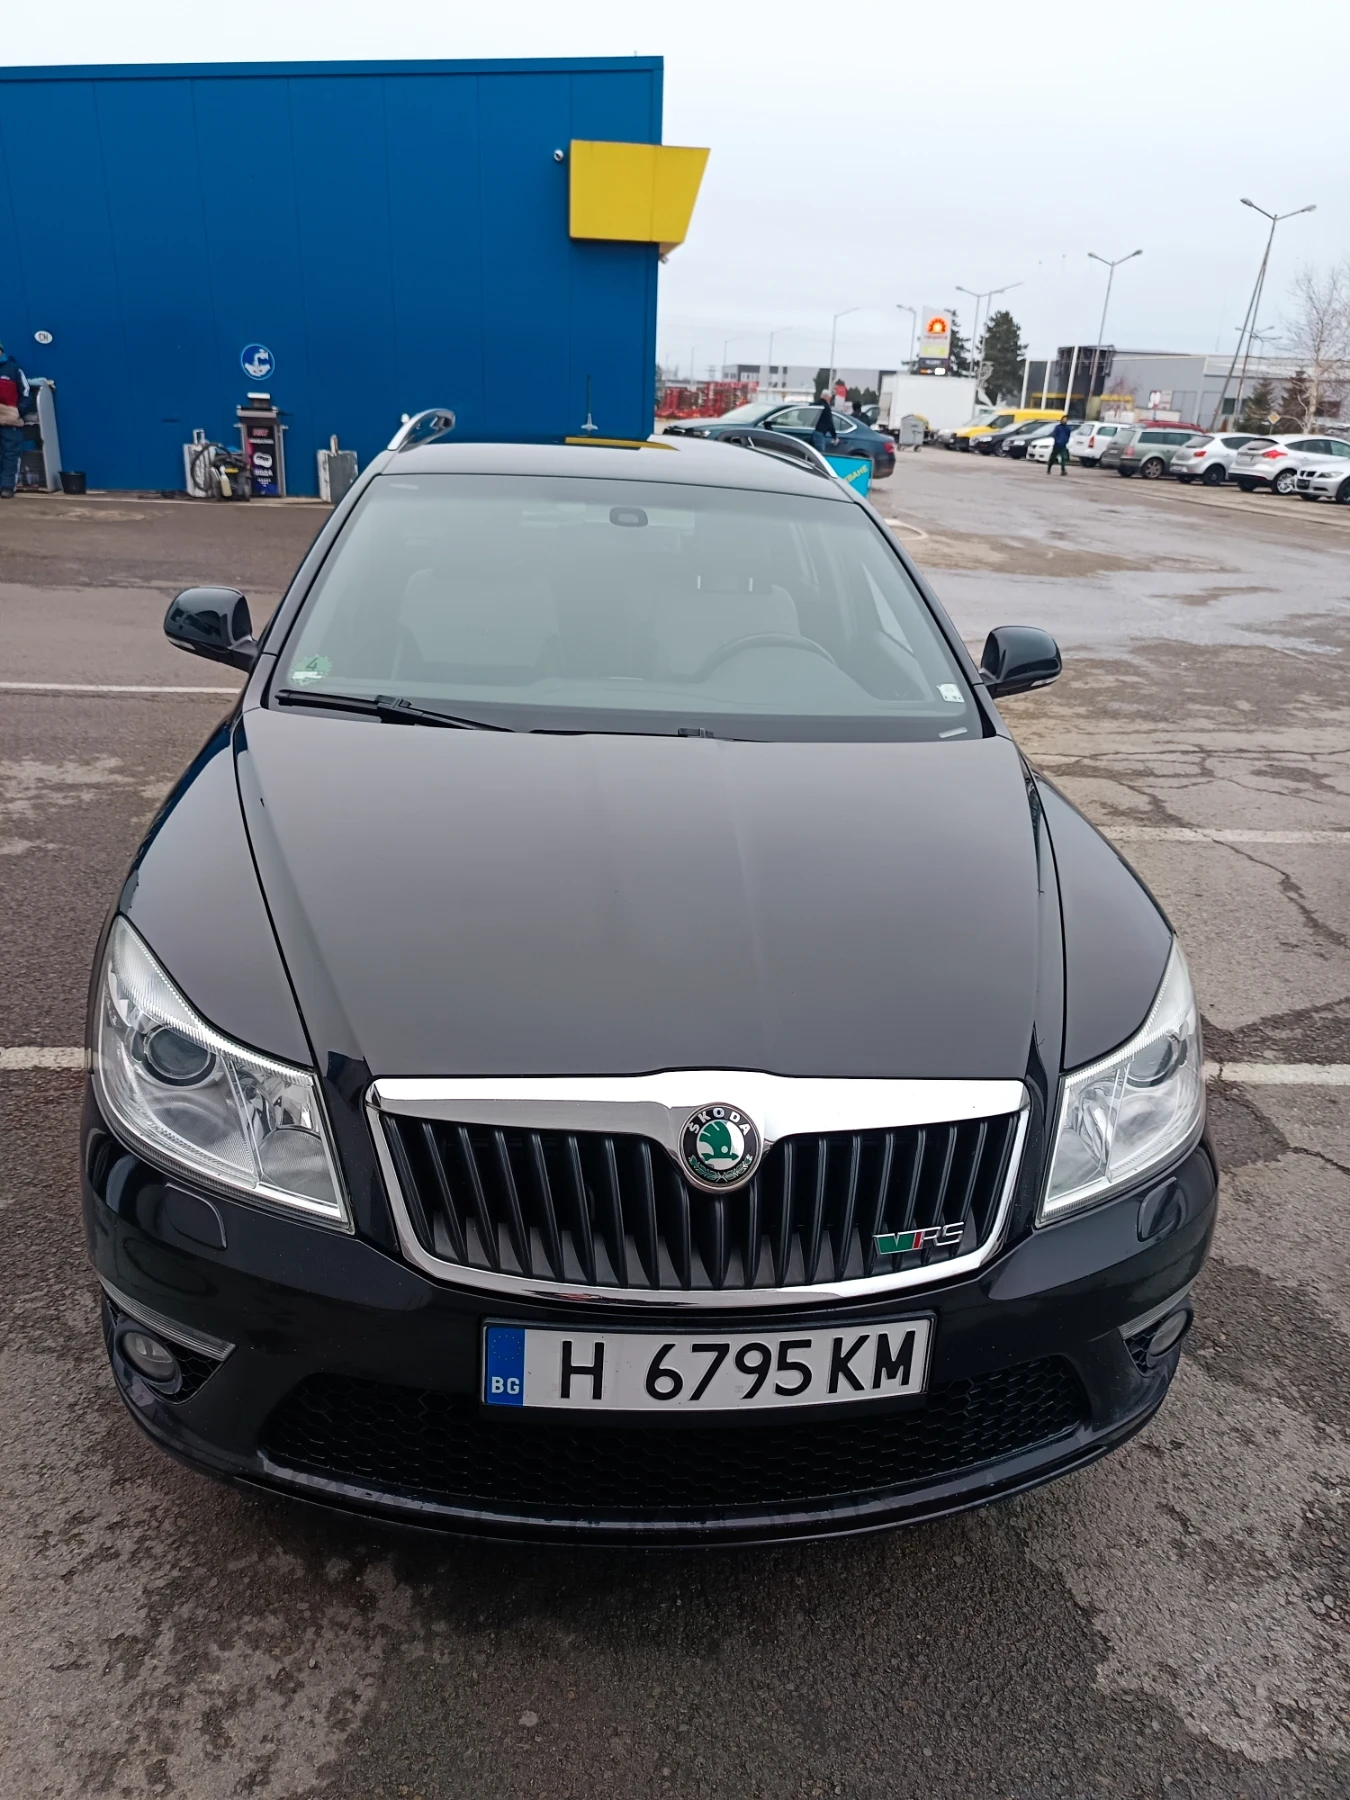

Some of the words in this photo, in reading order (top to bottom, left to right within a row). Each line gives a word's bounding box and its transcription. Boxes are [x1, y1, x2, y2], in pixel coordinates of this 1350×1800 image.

[306, 657, 319, 671] 4
[561, 1341, 604, 1399] H
[646, 1339, 812, 1400] 6795
[828, 1331, 915, 1393] KM
[491, 1376, 520, 1395] BG
